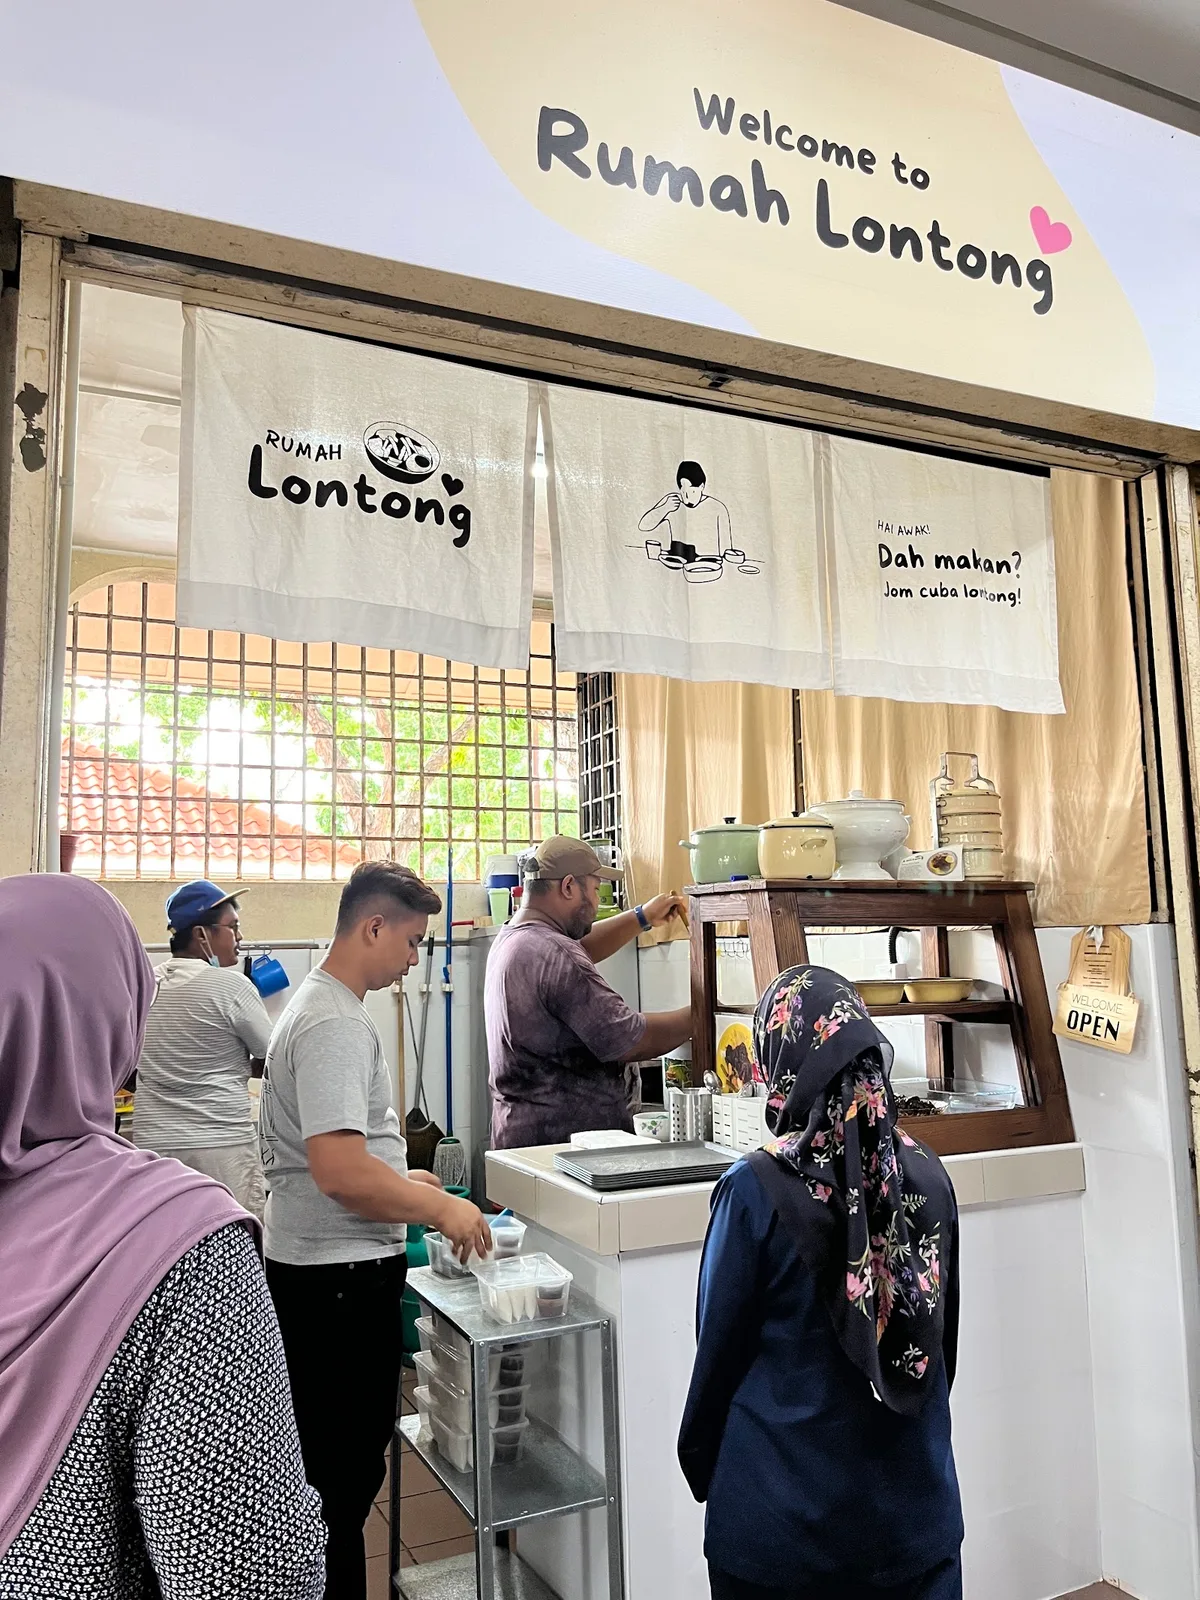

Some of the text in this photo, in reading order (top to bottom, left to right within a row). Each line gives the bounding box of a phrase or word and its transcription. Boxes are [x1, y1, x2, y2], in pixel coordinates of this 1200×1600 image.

[693, 87, 930, 191] Welcome to
[537, 105, 1054, 315] Rumah Lontong
[265, 429, 342, 462] RUMAH
[247, 443, 472, 549] Lontong
[877, 519, 931, 537] HAI AWAK!
[877, 543, 1022, 579] Dah makan?
[883, 581, 914, 598] Jom
[919, 582, 959, 598] cuba
[1072, 993, 1124, 1015] WELCOME
[1066, 1009, 1120, 1042] OPEN
